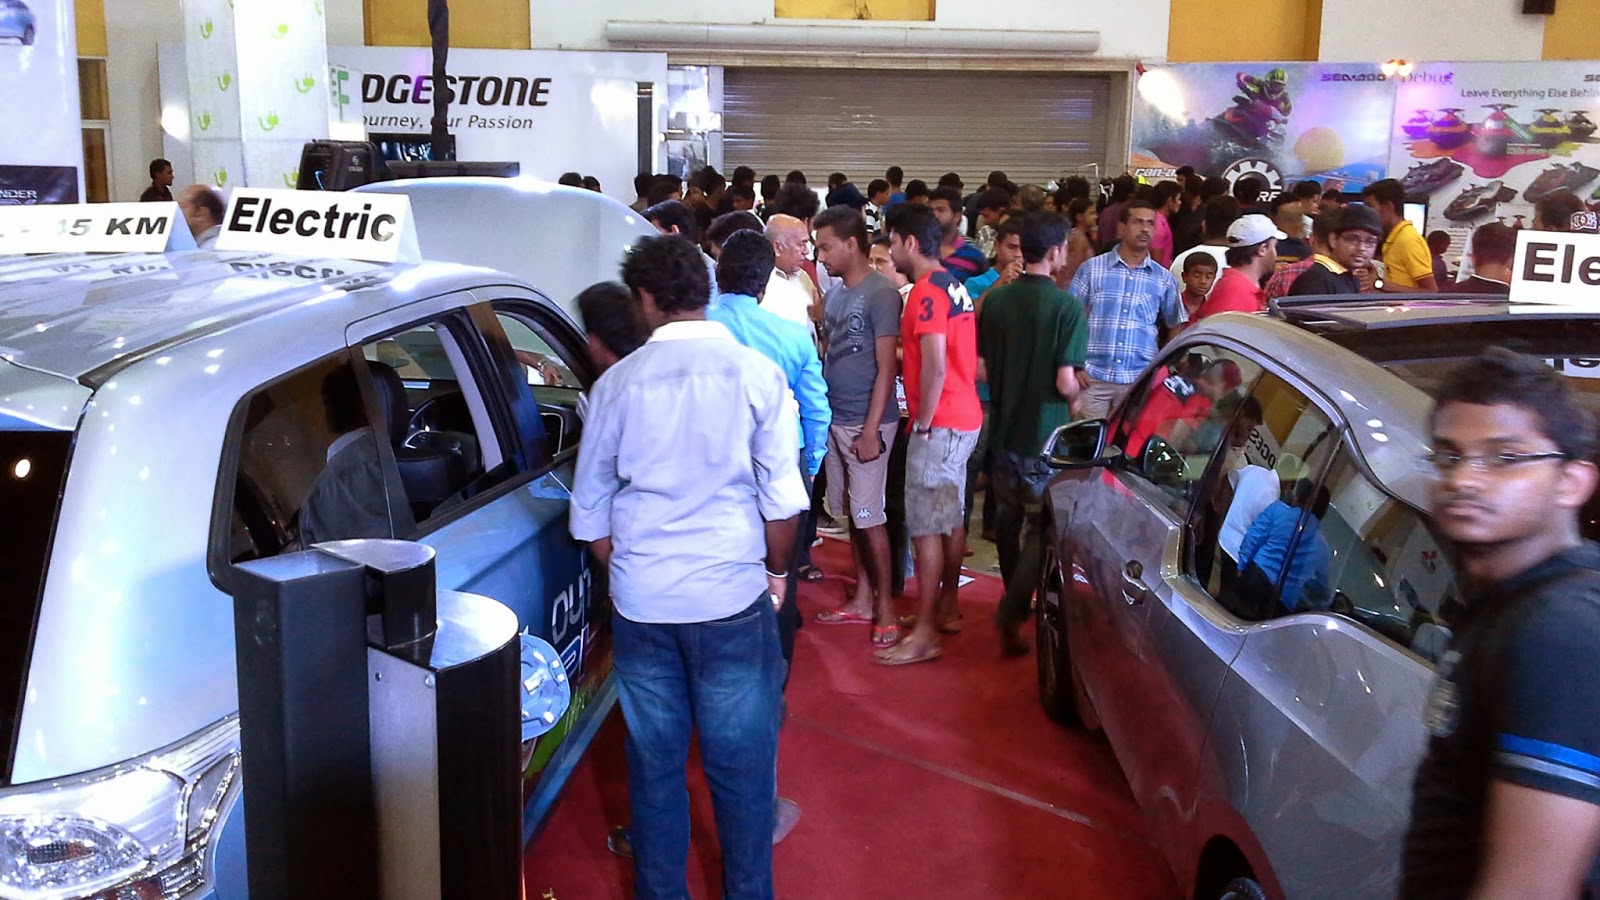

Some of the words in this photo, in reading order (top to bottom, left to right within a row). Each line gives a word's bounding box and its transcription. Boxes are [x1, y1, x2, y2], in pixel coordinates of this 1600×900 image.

[1461, 88, 1489, 98] Leave
[1492, 88, 1545, 99] Everything
[1548, 88, 1567, 98] Else
[430, 115, 463, 128] ur
[468, 115, 533, 128] Passion
[105, 216, 168, 235] KM
[228, 196, 396, 242] Electric
[919, 296, 934, 321] 3
